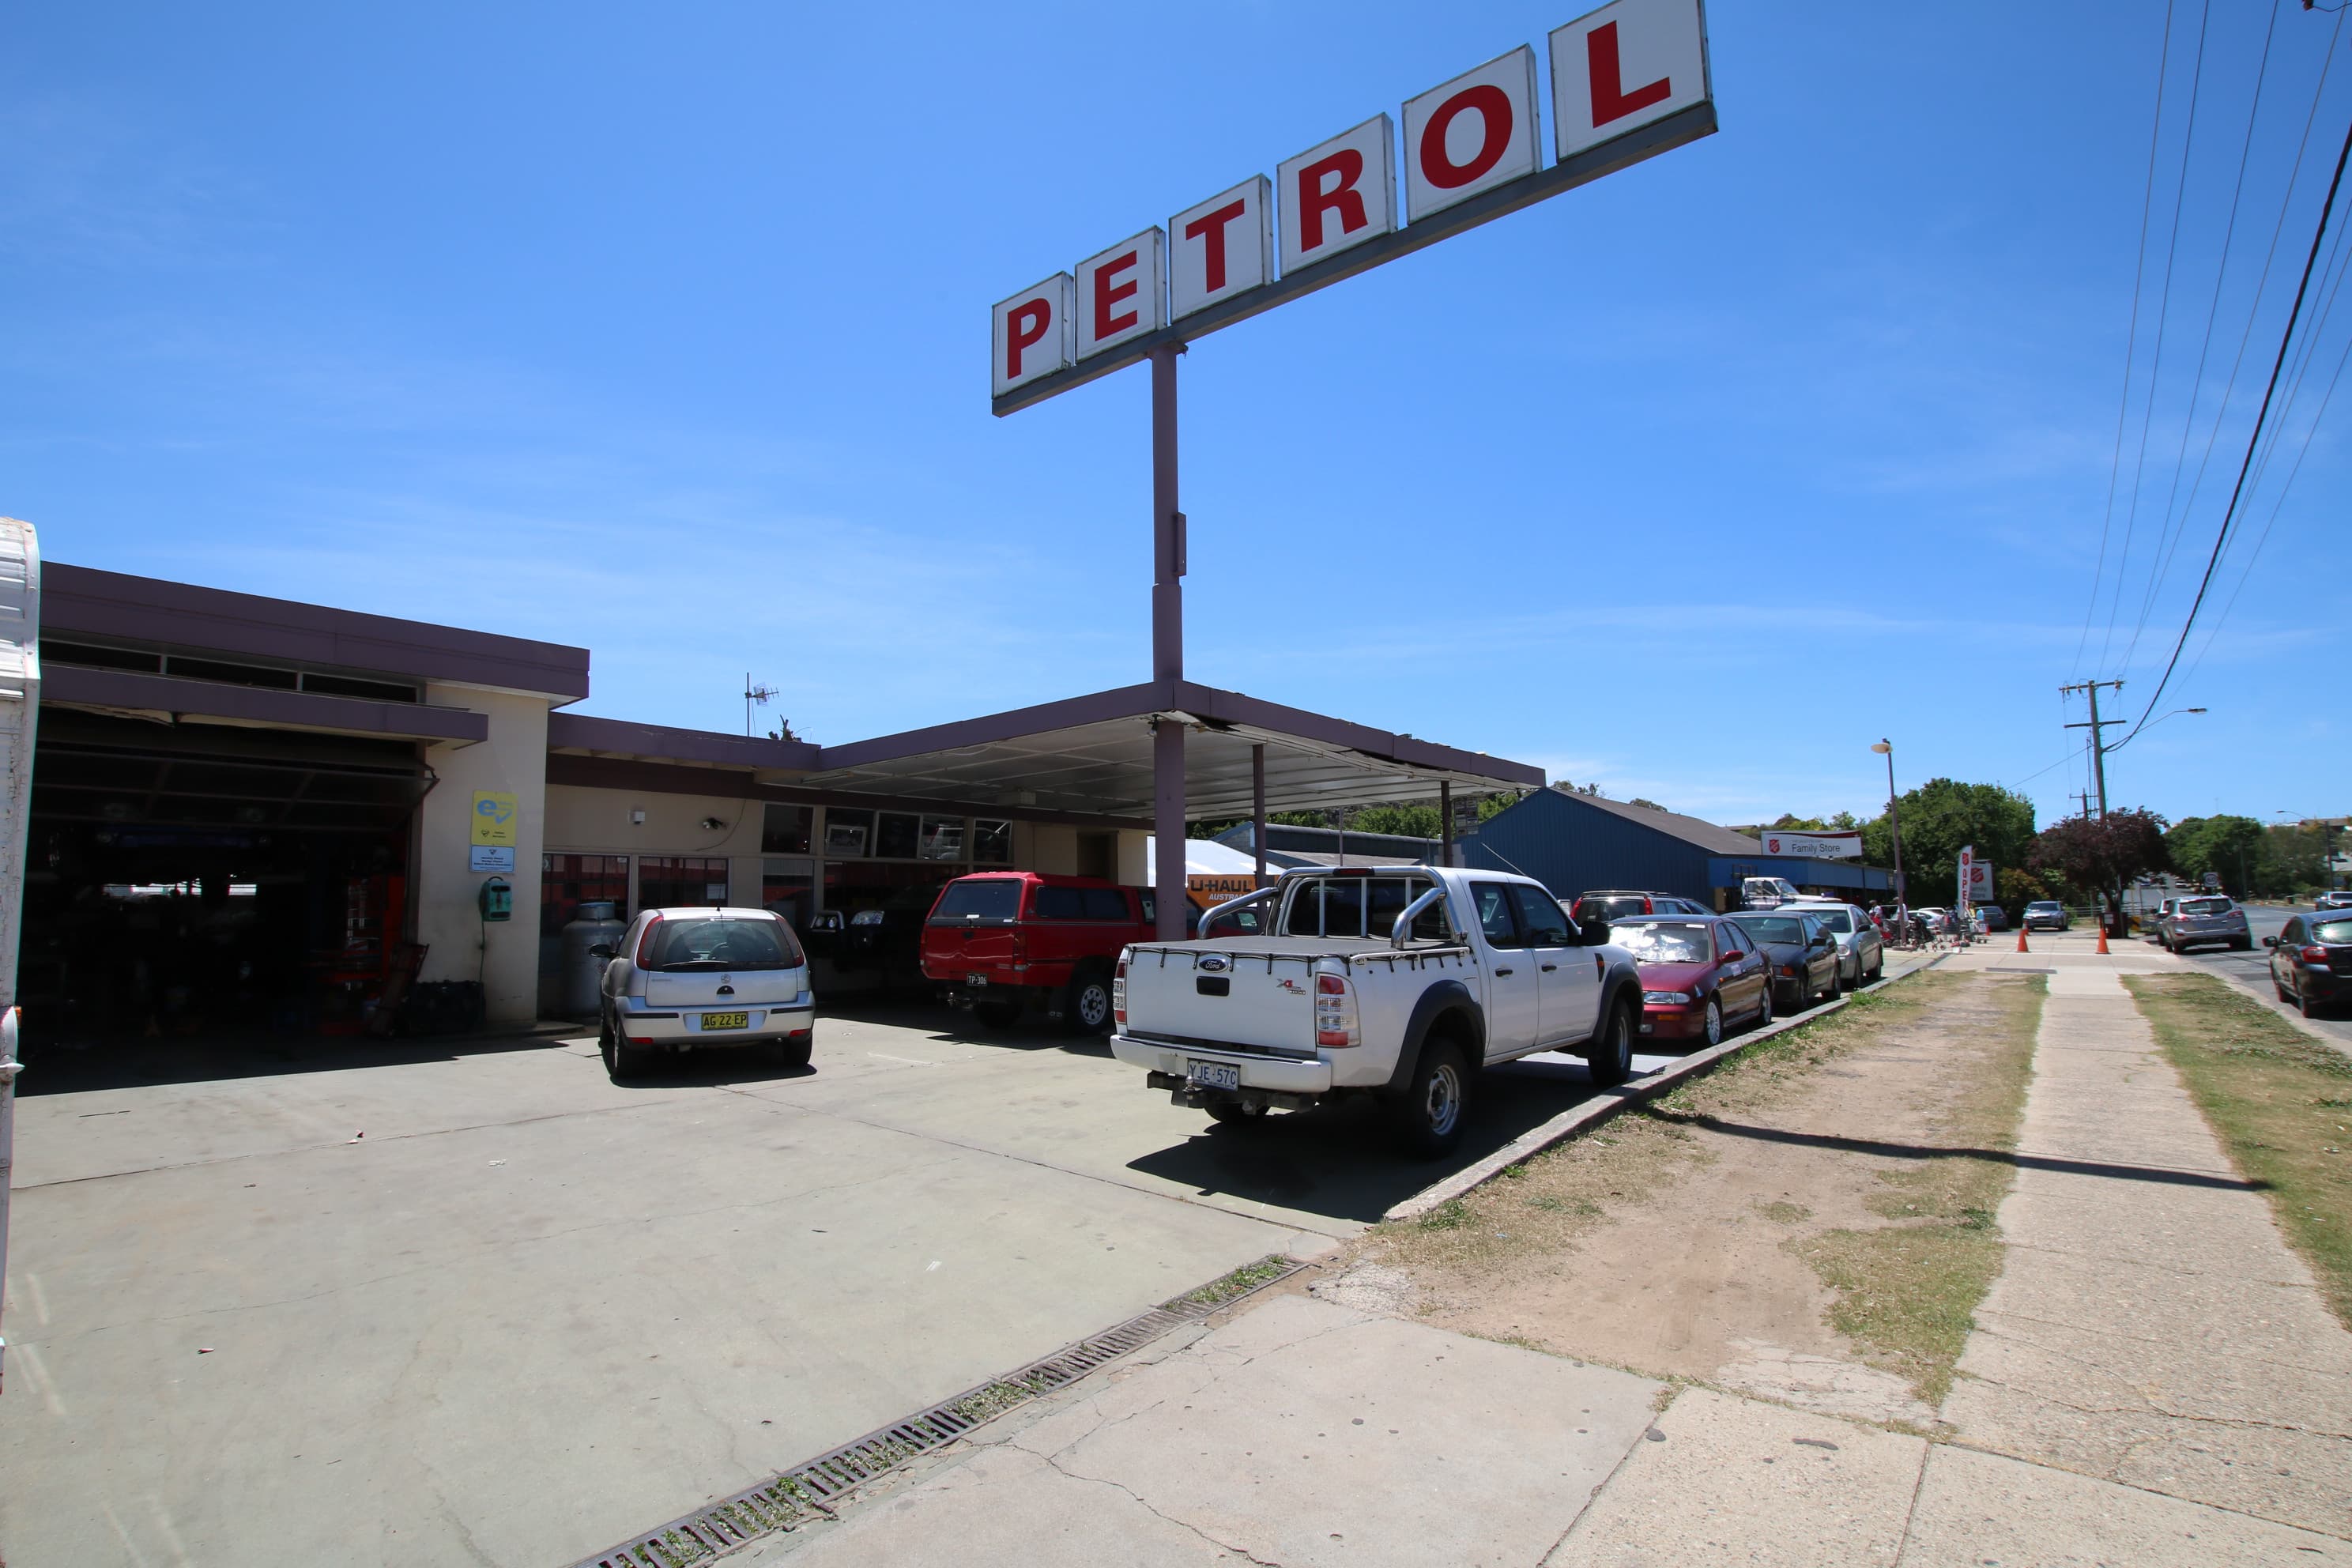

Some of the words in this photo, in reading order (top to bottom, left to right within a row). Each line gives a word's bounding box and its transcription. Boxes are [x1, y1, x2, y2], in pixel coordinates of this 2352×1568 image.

[1007, 21, 1671, 380] PETROL
[1791, 843, 1817, 854] Family
[1819, 843, 1841, 853] Store
[1190, 879, 1252, 892] U-HAUL
